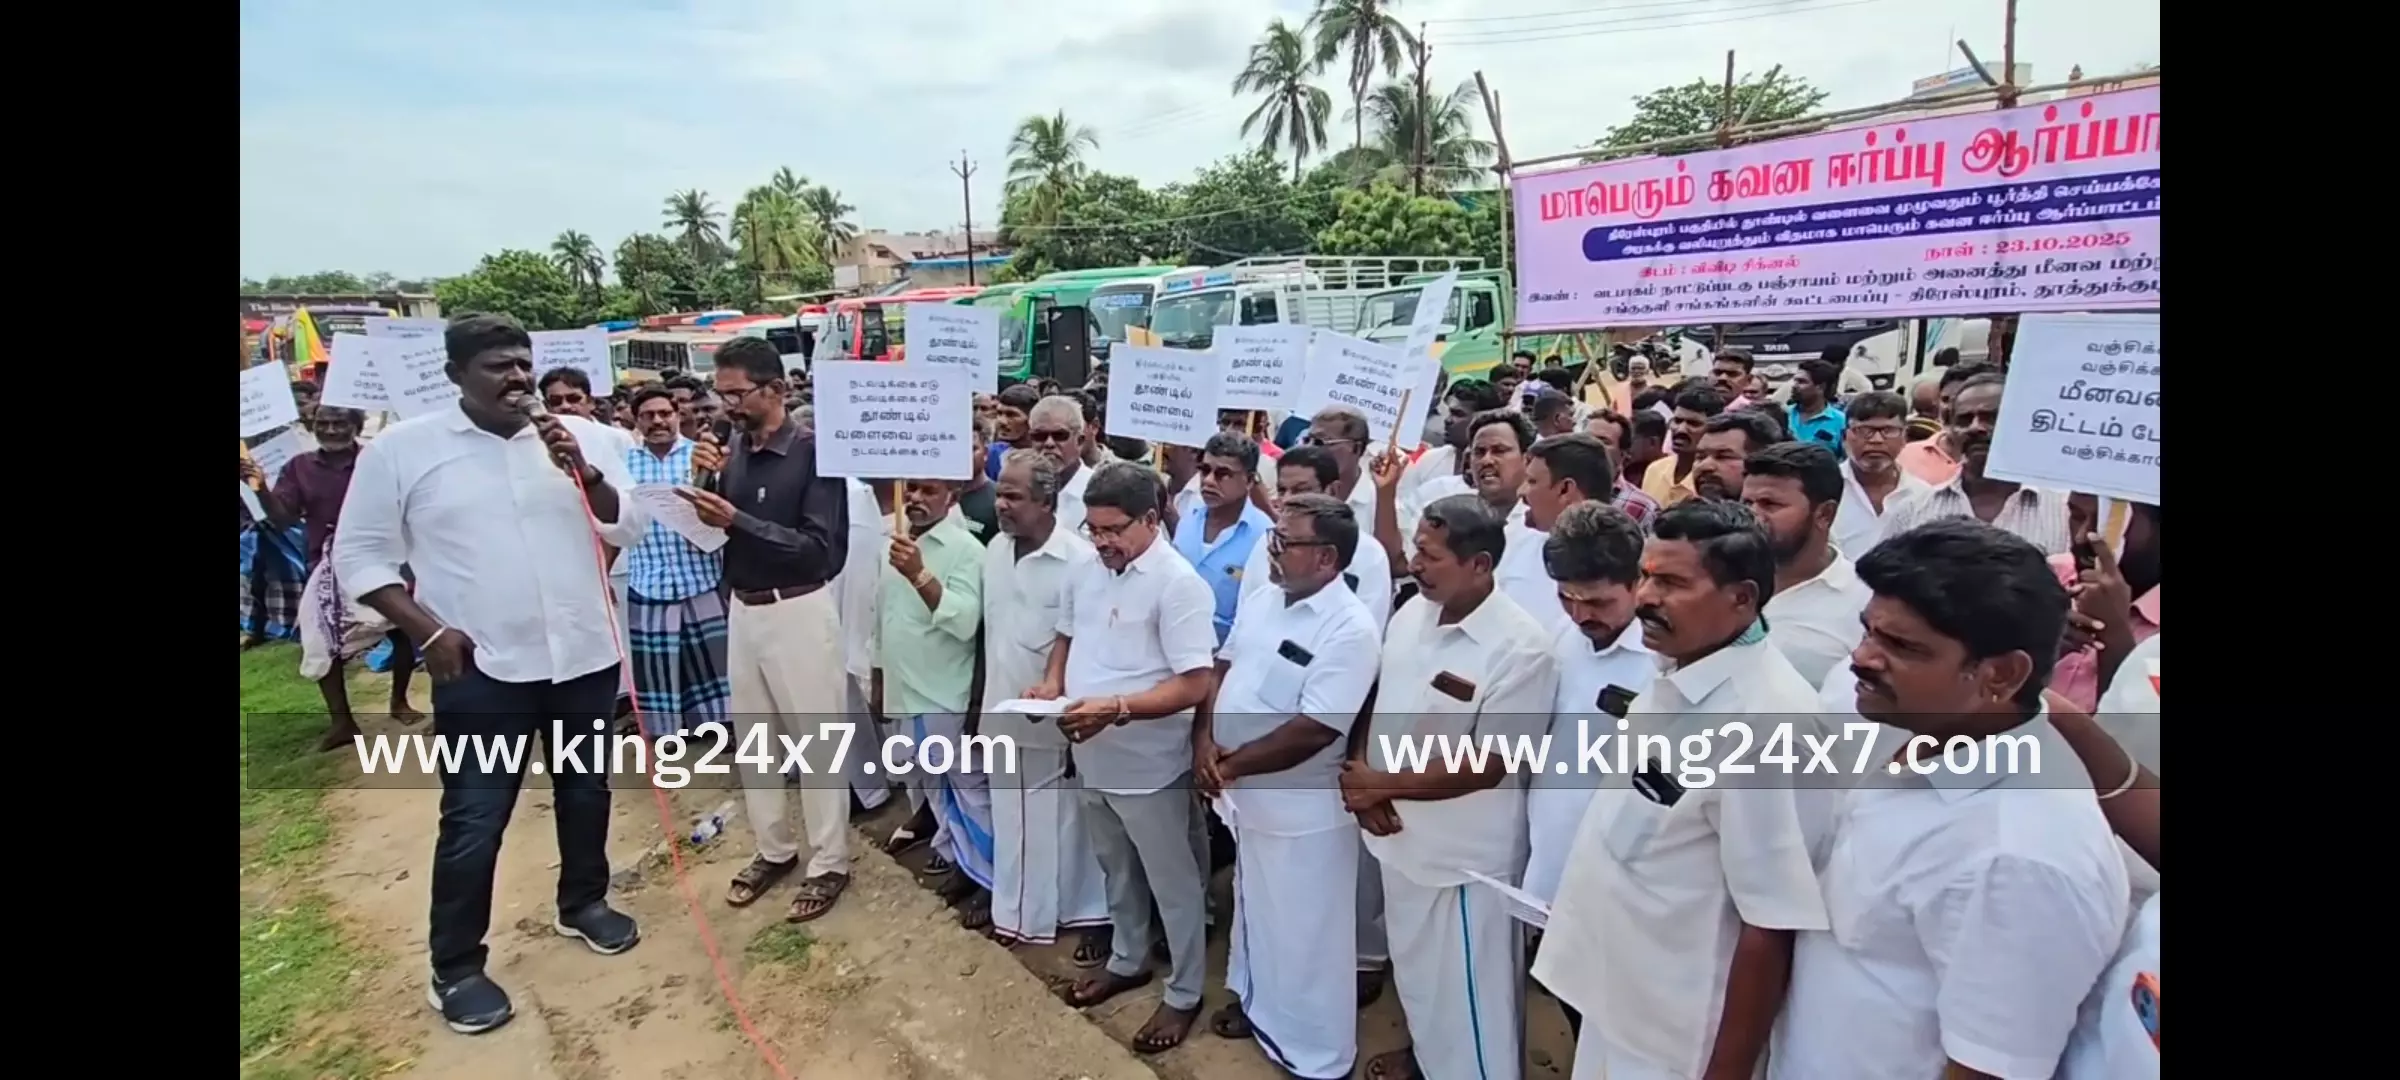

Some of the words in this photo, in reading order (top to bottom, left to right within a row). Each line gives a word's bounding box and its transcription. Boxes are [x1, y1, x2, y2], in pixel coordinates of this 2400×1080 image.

[1540, 158, 1696, 221] மாபெரும்
[1708, 158, 1814, 202] கவன
[1827, 127, 1946, 188] ஈர்ப்பு
[1741, 209, 1808, 231] தூண்டில்
[1811, 203, 1891, 221] வளைவை
[1894, 192, 1982, 216] முழுவதும்
[1986, 185, 2049, 208] பூர்த்தி
[1774, 229, 1838, 243] விதமாக
[1841, 217, 1921, 237] மாபெரும்
[1924, 214, 1974, 230] கவன
[1979, 209, 2030, 226] ஈர்ப்பு
[1924, 241, 1974, 260] நாள்
[1995, 231, 2132, 255] 23.10.2025
[1742, 254, 1800, 271] சிக்னல்
[1845, 267, 1917, 287] மற்றும்
[1922, 260, 2028, 281] அனைத்து
[2034, 257, 2102, 275] மீனவ
[1763, 343, 1790, 352] TATA
[1231, 356, 1284, 370] தூண்டில்
[849, 379, 918, 391] நடவடிக்கை
[920, 379, 940, 391] எடு
[1226, 374, 1284, 385] வளைவை
[849, 394, 918, 405] நடவடிக்கை
[920, 394, 940, 406] எடு
[1133, 383, 1193, 400] தூண்டில்
[859, 408, 931, 424] தூண்டில்
[1130, 401, 1194, 418] வளைவை
[2029, 408, 2123, 438] திட்டம்
[834, 429, 913, 442] வளைவை
[916, 432, 957, 443] முடிக்க
[851, 447, 919, 458] நடவடிக்கை
[921, 448, 941, 459] எடு
